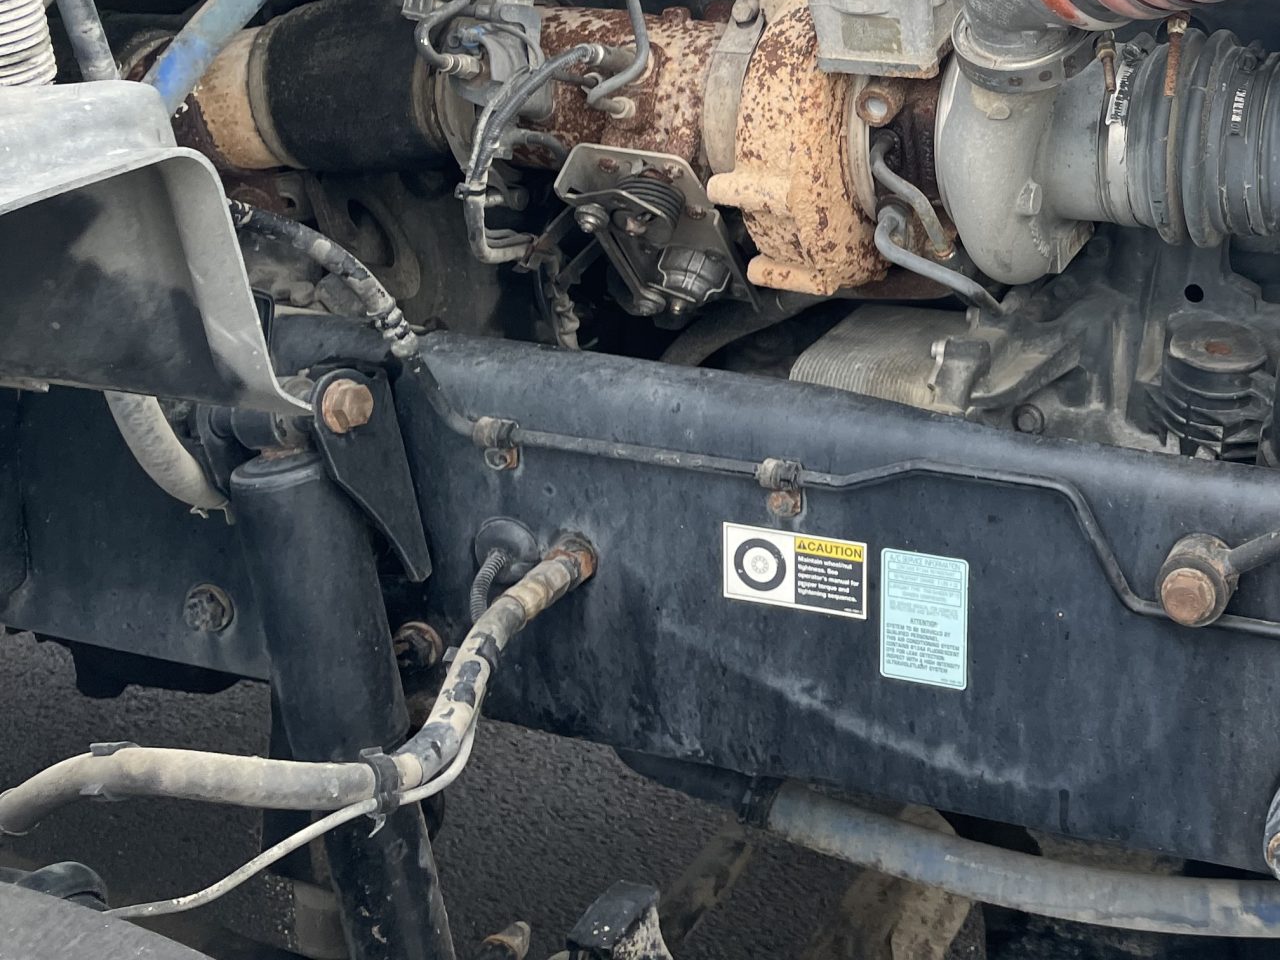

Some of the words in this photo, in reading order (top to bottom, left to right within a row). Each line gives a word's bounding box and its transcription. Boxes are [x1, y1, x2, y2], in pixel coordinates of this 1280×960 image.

[808, 543, 862, 559] CAUTION
[798, 556, 823, 565] Maintain
[798, 564, 825, 574] tightness.
[798, 572, 827, 583] operator's
[829, 577, 850, 585] manual
[819, 584, 837, 592] torque
[798, 588, 826, 598] tightening
[828, 593, 857, 602] sequence.
